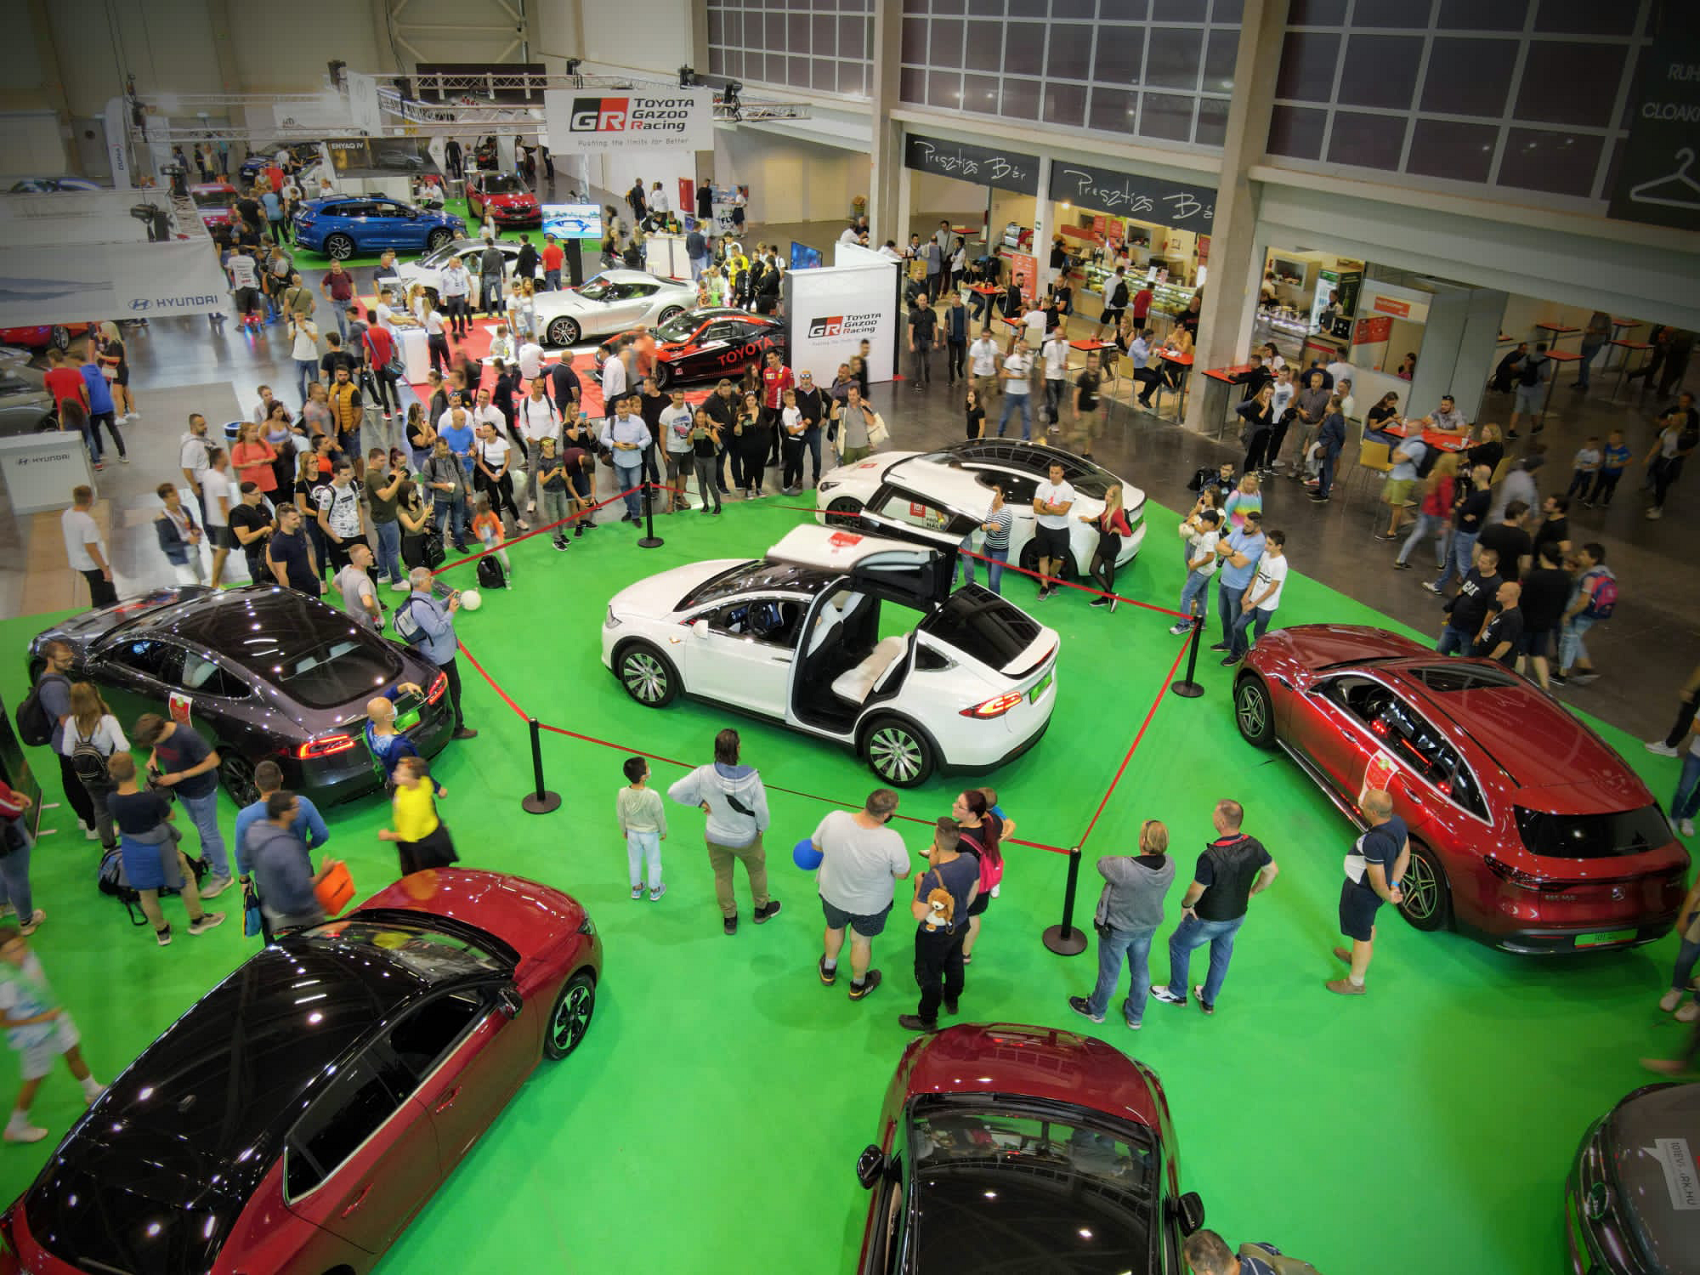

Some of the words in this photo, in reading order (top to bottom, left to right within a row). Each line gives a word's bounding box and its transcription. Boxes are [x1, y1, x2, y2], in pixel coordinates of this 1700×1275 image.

[634, 98, 695, 108] TOYOTA
[632, 110, 688, 119] GAZOO
[1642, 102, 1700, 122] CLOAK
[630, 120, 686, 133] Racing
[612, 139, 623, 147] the
[157, 295, 219, 307] HYUNDAI
[845, 313, 881, 321] TOYOTA
[844, 320, 877, 328] GAZOO
[717, 338, 774, 366] TOYOTA
[32, 454, 70, 463] HYUNDAI
